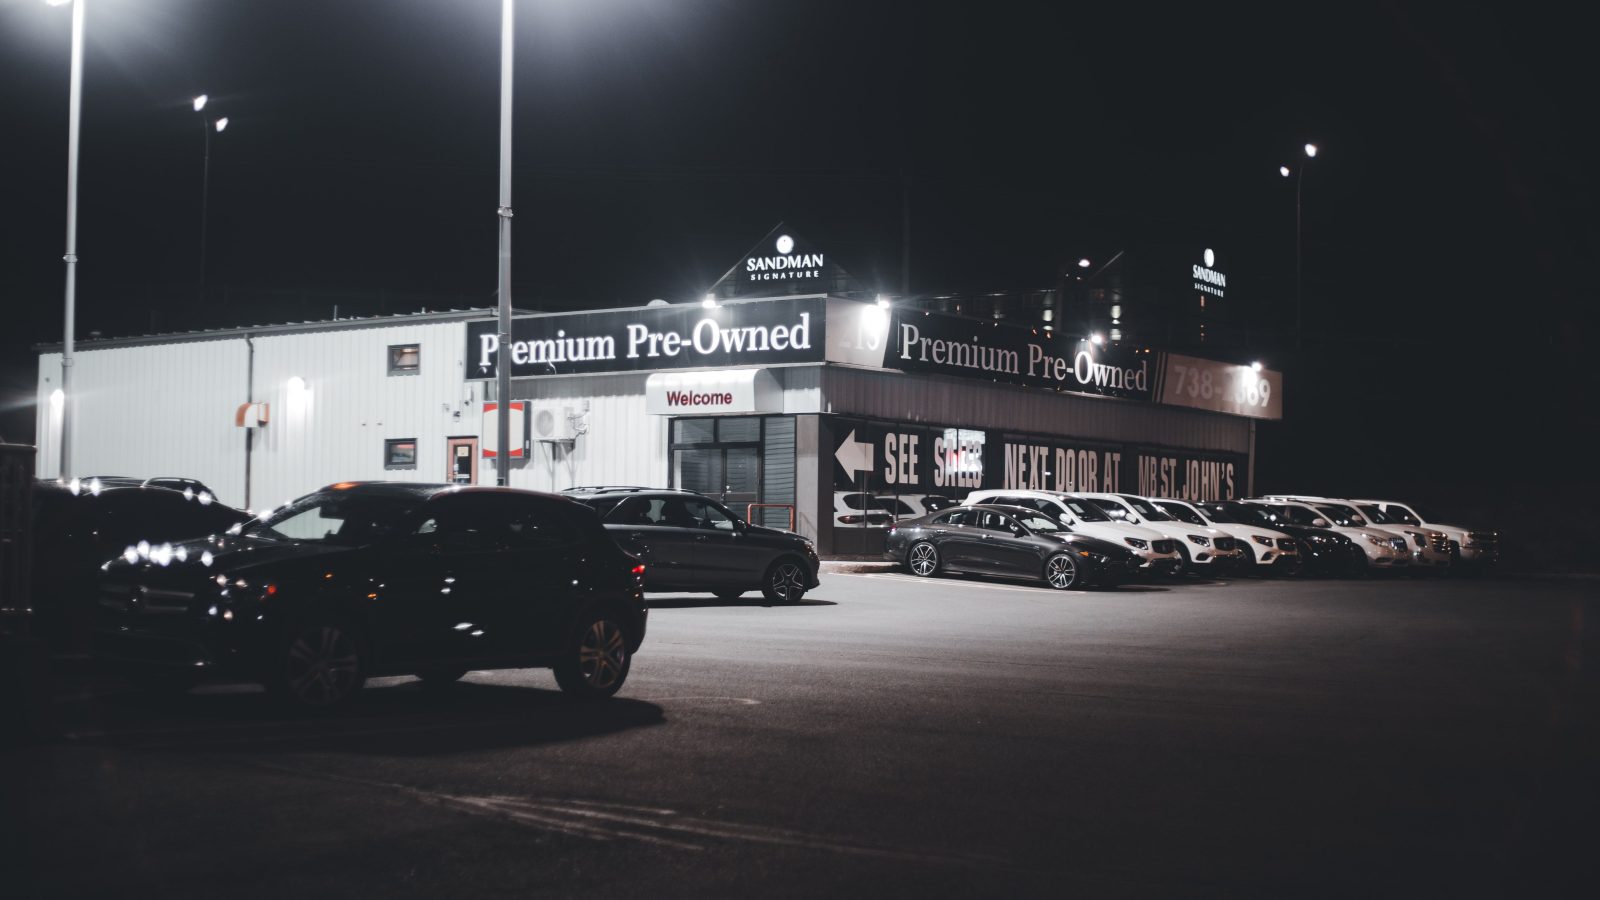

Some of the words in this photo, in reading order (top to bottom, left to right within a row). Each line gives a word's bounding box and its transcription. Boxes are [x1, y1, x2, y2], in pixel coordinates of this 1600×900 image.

[746, 254, 823, 271] SANDMAN
[750, 270, 819, 281] SIGNATURE
[1192, 264, 1226, 287] SANDMAN
[479, 329, 616, 366] Pemium
[626, 312, 811, 359] Pre-Owned
[900, 323, 1019, 375] Premium
[1027, 343, 1148, 392] Pre-Owned
[666, 390, 733, 407] Welcome
[884, 432, 919, 485] SEE
[934, 436, 983, 489] SALES
[1004, 443, 1049, 491] NEXT
[1055, 447, 1098, 493] DOOR
[1103, 451, 1121, 494] AT
[1138, 455, 1157, 498] MB
[1160, 457, 1180, 499] ST.
[1182, 459, 1234, 502] JOHN'S
